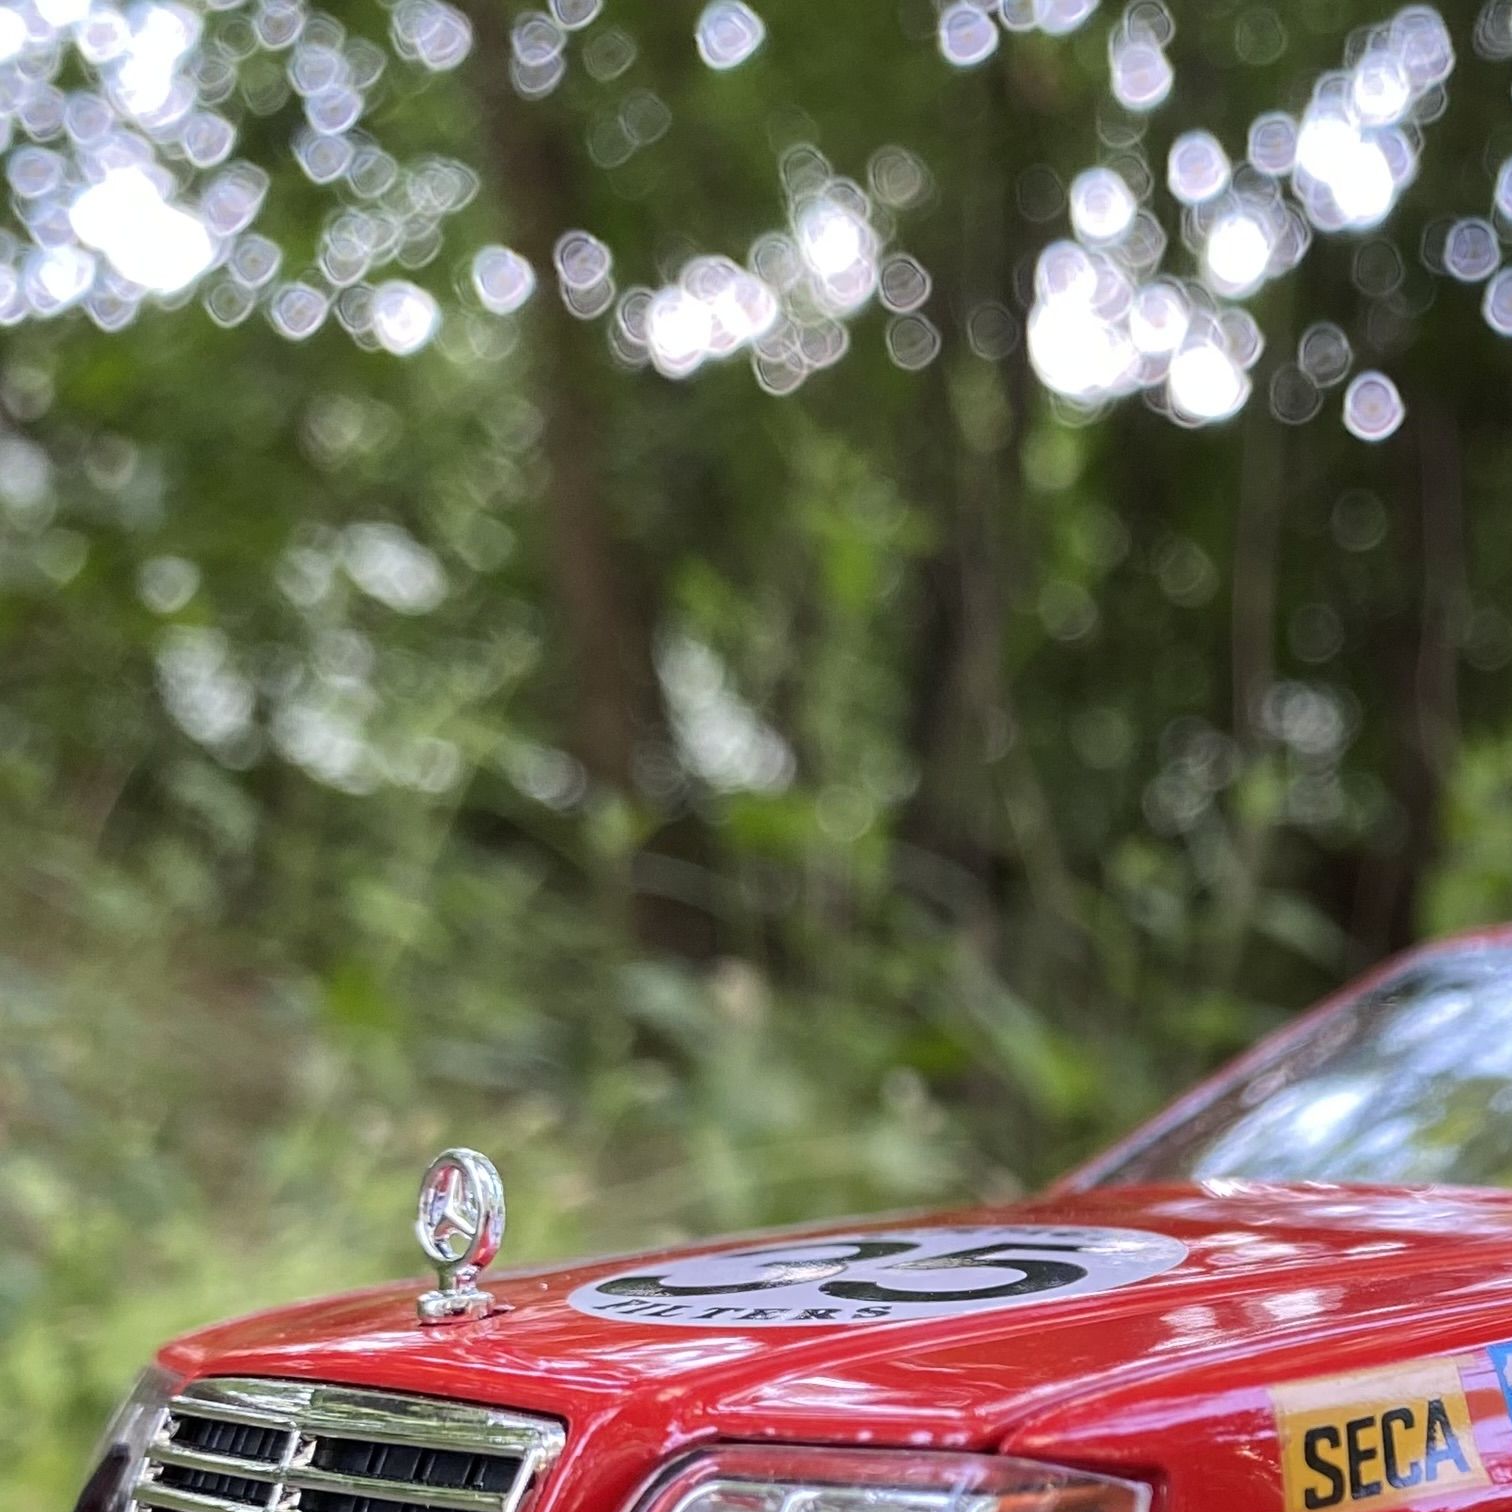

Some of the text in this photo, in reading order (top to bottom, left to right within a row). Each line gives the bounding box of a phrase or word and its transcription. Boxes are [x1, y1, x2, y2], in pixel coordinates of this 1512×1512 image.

[595, 1240, 1089, 1302] 35
[592, 1298, 892, 1321] FILTERS
[1304, 1398, 1471, 1511] SECA
